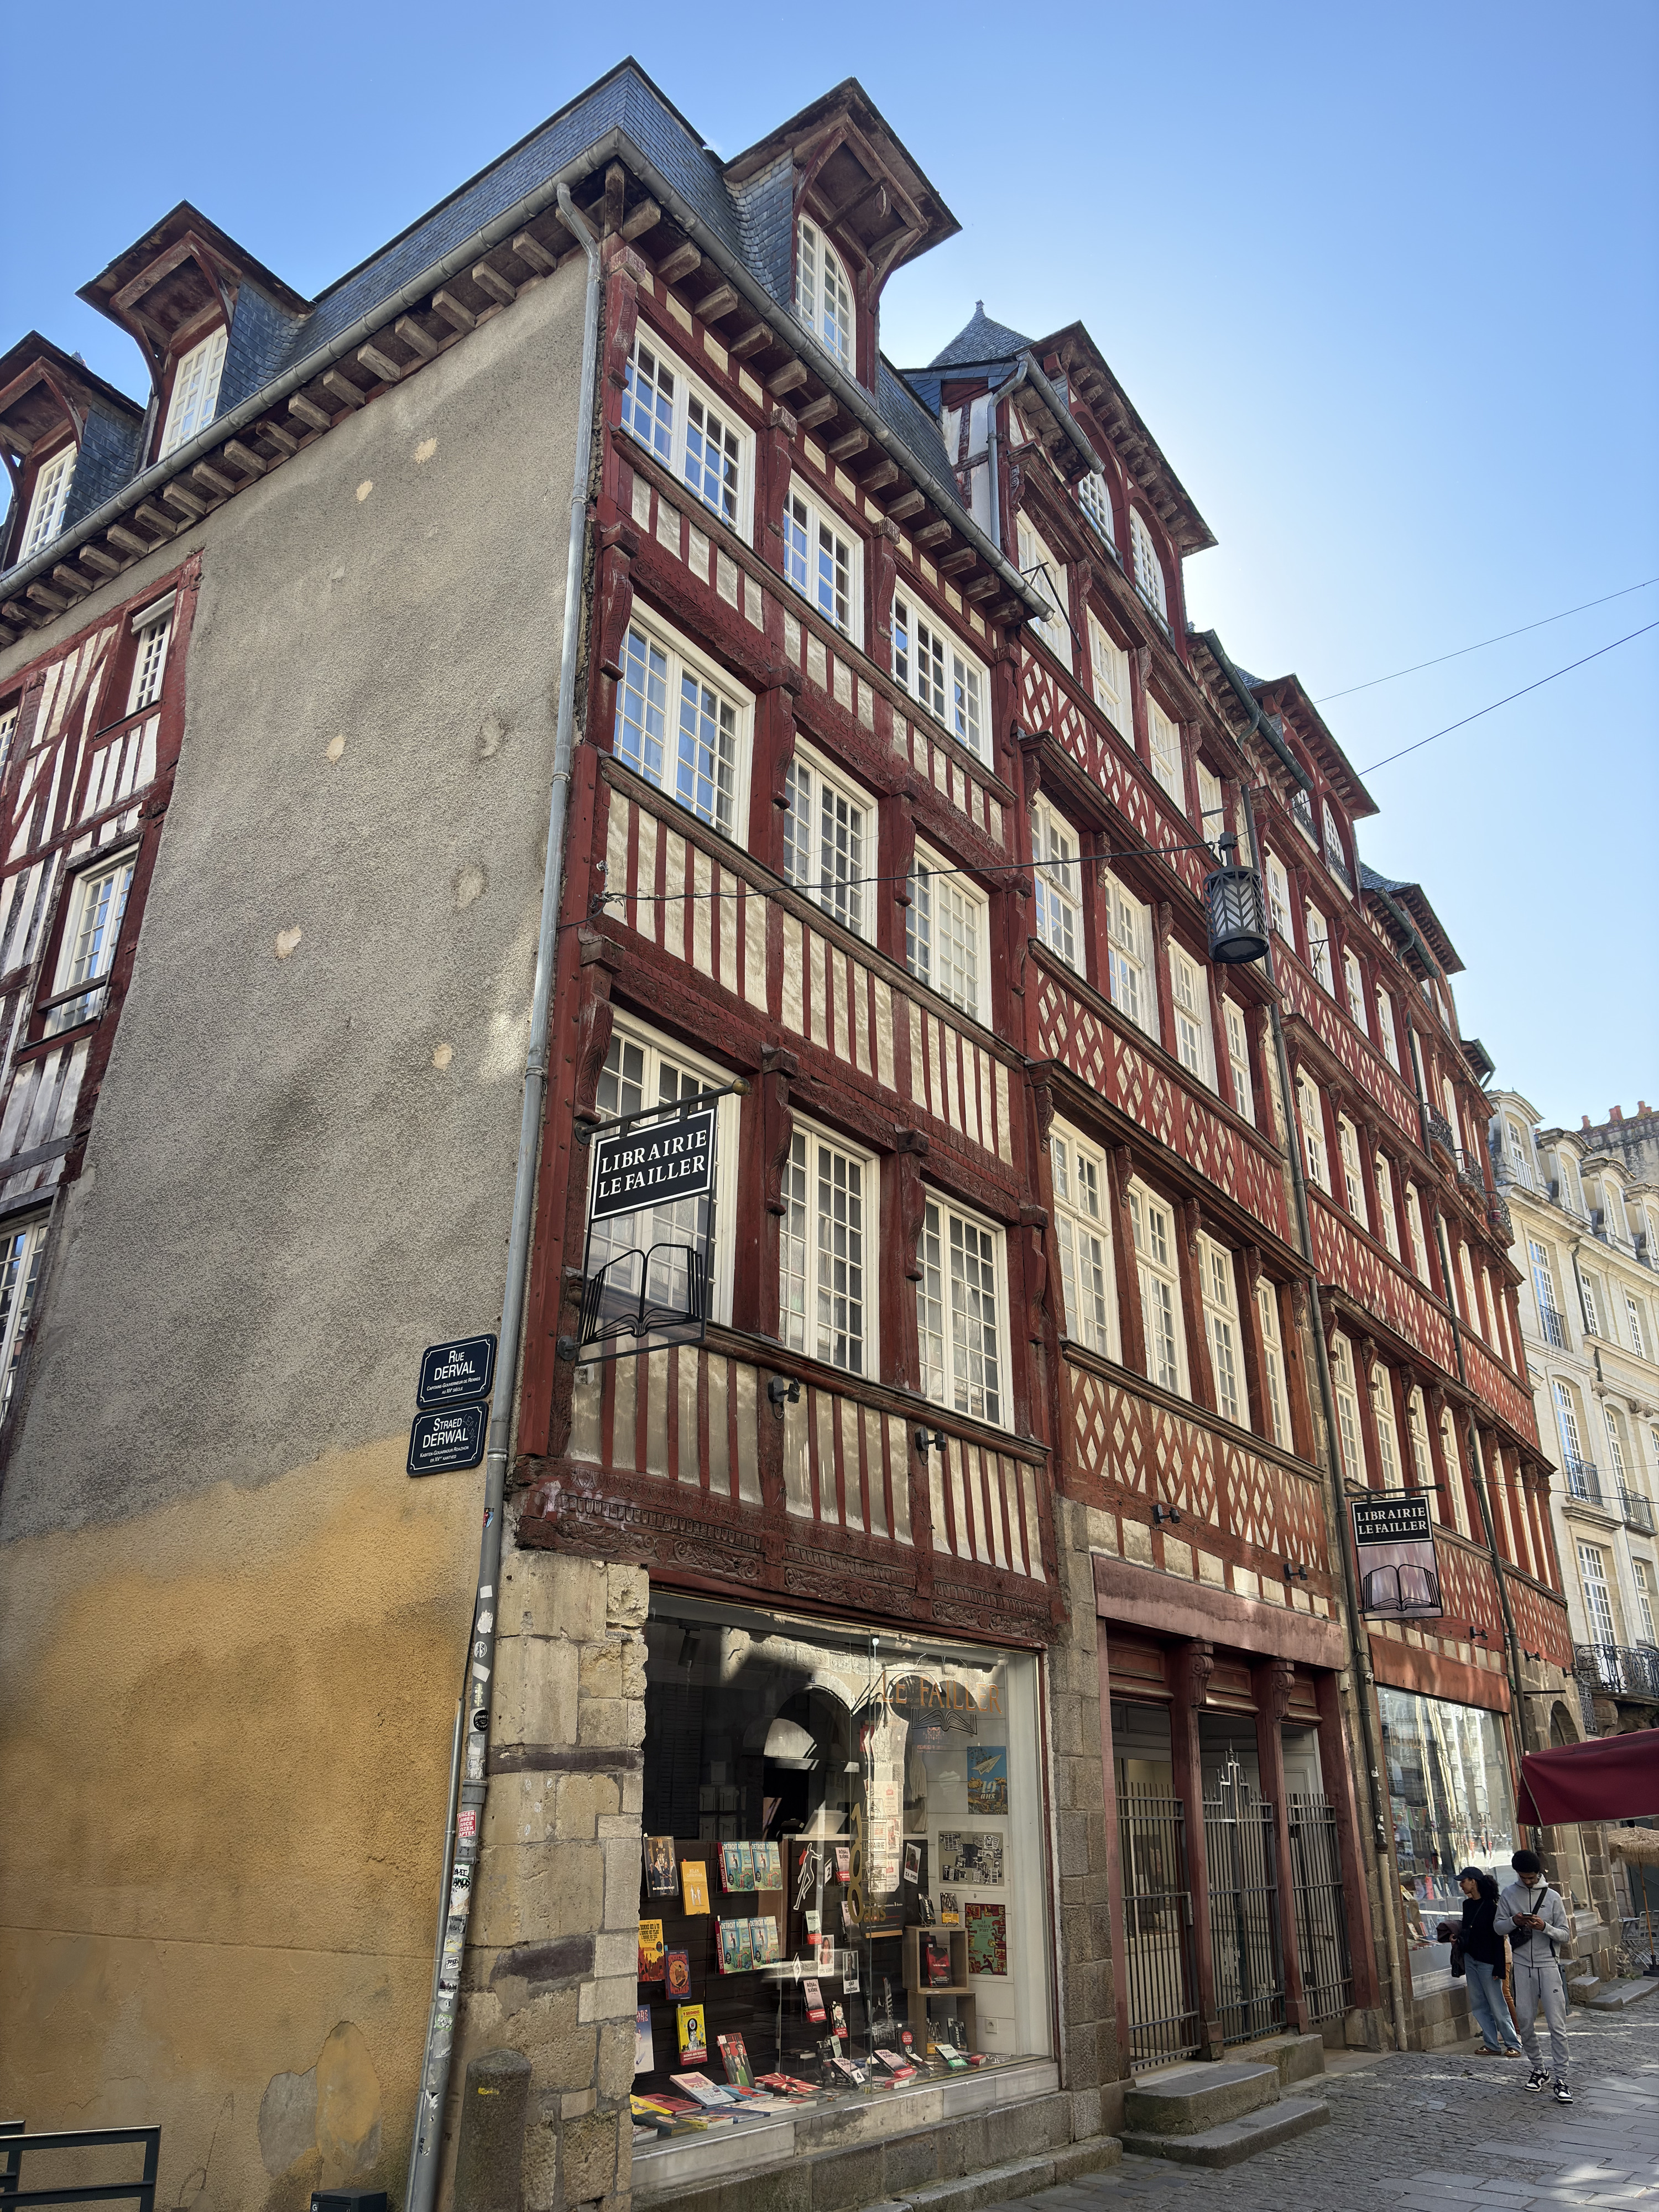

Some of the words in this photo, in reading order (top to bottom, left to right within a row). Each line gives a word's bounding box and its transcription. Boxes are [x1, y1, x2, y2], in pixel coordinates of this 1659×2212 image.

[601, 1130, 707, 1174] LIBRAIRIE
[598, 1177, 622, 1198] LE
[624, 1155, 705, 1192] FAILLER
[434, 1360, 476, 1381] DERVAL
[433, 1417, 462, 1432] STRAED
[422, 1427, 469, 1448] DERWAL
[1357, 1507, 1426, 1522] LIBRAIRIE
[1358, 1525, 1374, 1535] LE
[1375, 1520, 1428, 1533] FAILLER
[883, 1670, 907, 1704] LE
[920, 1676, 1003, 1714] FAILLER
[827, 1866, 831, 1878] 2
[863, 1905, 886, 1923] ans
